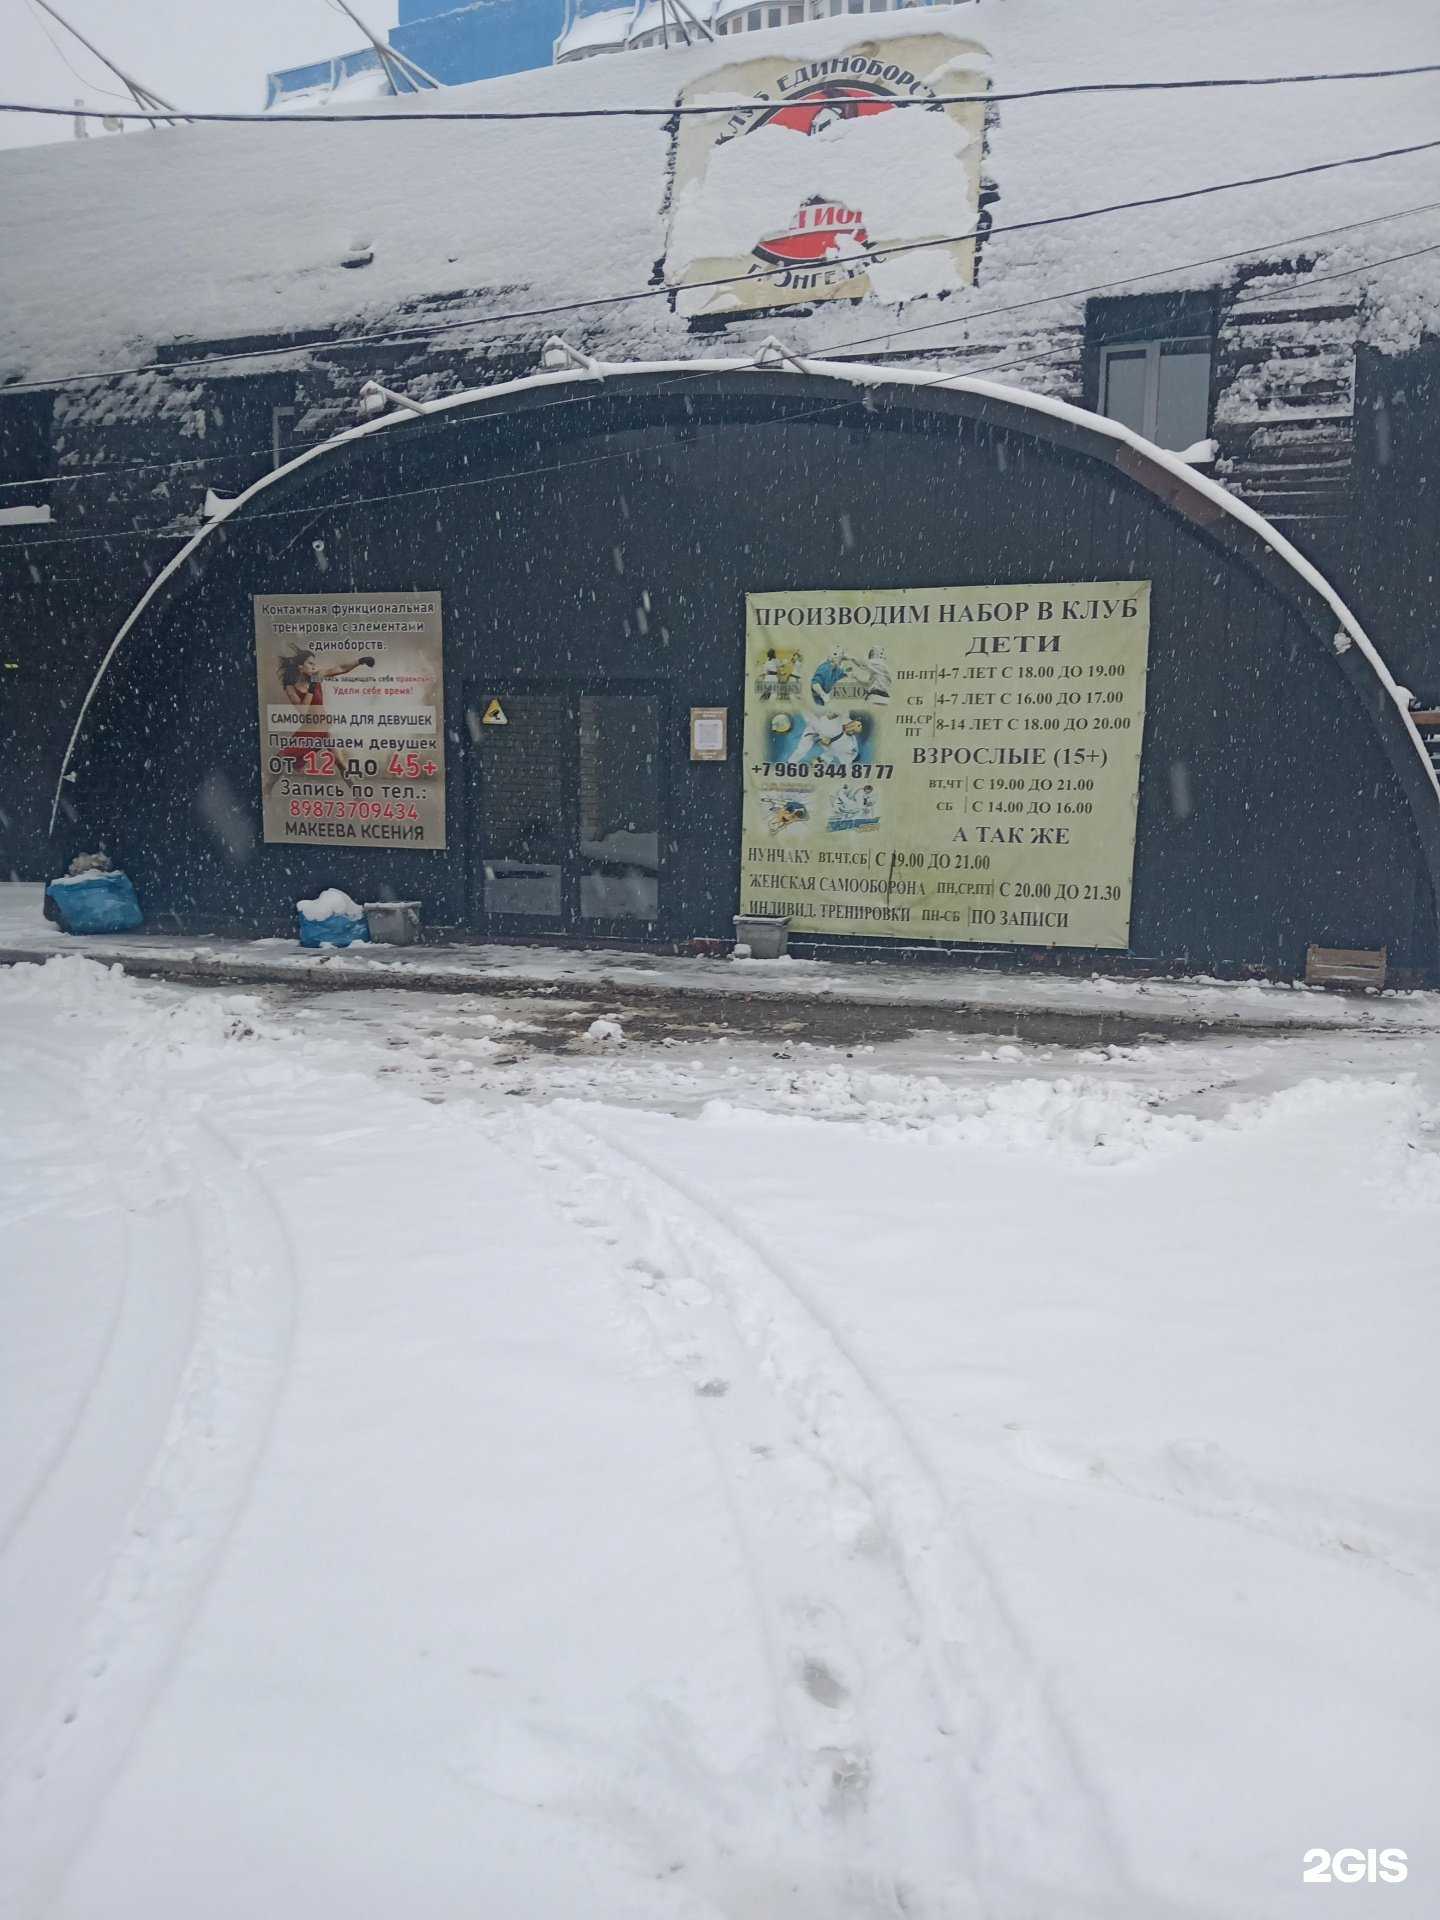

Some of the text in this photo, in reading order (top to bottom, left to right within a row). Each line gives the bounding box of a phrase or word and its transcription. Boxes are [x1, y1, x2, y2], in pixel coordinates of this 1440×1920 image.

[262, 603, 434, 617] Контактная функциональная
[755, 598, 1138, 627] ПРОИЗВОДИМ НАБОР В КЛУБ
[272, 623, 338, 635] тренировка
[352, 622, 424, 632] элементами
[308, 641, 387, 652] единоборств.
[965, 635, 1063, 656] ДЕТИ
[897, 664, 1126, 680] ПН-ПТ 4-7 ЛЕТ С 18.00 ДО 19.00
[333, 686, 360, 697] Удели
[362, 686, 381, 696] себе
[907, 691, 1124, 706] СБ 4-7 ЛЕТ С 16.00 ДО 17.00
[271, 713, 432, 727] САМООБОРОНА ДЛЯ ДЕВУШЕК
[936, 717, 1131, 732] 8-14 ЛЕТ С 18.00 ДО 20.00
[905, 727, 922, 737] ПТ
[269, 734, 437, 750] Приглашаем девушек
[303, 751, 336, 776] 12
[345, 758, 378, 778] до
[388, 752, 438, 778] 45+
[912, 747, 1108, 768] ВЗРОСЛЫЕ (15+)
[752, 762, 771, 776] +7
[775, 762, 809, 777] 960
[814, 763, 847, 778] 344
[281, 779, 427, 800] Запись по тел.:
[973, 778, 985, 791] С
[989, 778, 1025, 791] 19.00
[1028, 779, 1053, 792] ДО
[1057, 779, 1094, 791] 21.00
[290, 801, 418, 820] 89873709434
[936, 801, 1093, 815] СБ С 14.00 ДО 16.00
[285, 822, 424, 841] МАКЕЕВА КСЕНИЯ
[952, 826, 1070, 845] А ТАК ЖЕ
[748, 847, 810, 864] НУНЧАКУ
[875, 851, 886, 867] С
[892, 851, 925, 868] 19.00
[927, 853, 950, 870] ДО
[955, 854, 990, 870] 21.00
[750, 873, 816, 891] ЖЕНСКАЯ
[820, 876, 926, 896] САМООБОРОНА
[1000, 881, 1011, 897] С
[1015, 882, 1051, 898] 20.00
[1054, 883, 1079, 900] ДО
[1084, 885, 1121, 901] 21.30
[749, 900, 1069, 928] ИНДИВИД. ТРЕНИРОВКИ ПН-СБ ПО ЗАПИСИ
